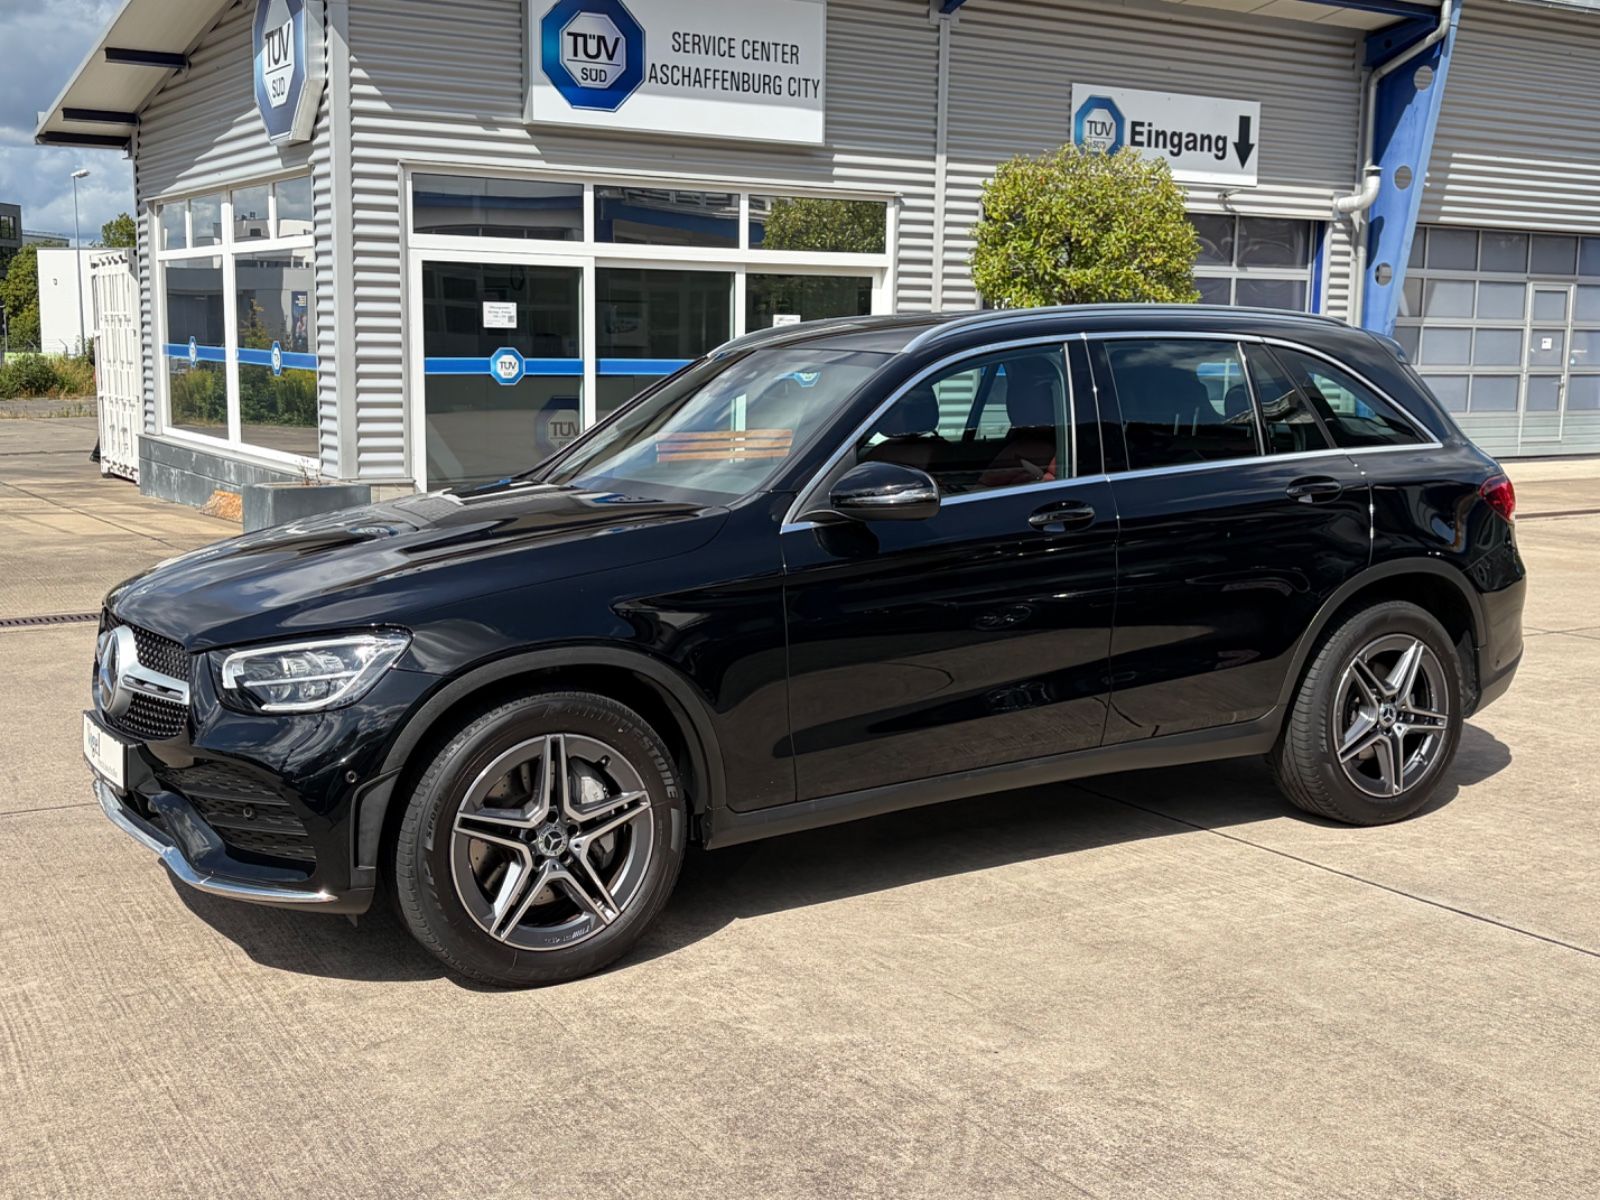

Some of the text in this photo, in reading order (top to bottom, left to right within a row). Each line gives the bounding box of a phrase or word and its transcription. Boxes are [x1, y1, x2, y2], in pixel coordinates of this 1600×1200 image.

[265, 23, 290, 67] TÜV
[567, 32, 621, 61] TÜV
[671, 31, 799, 64] SERVICE CENTER
[581, 68, 607, 83] SÜD
[648, 63, 820, 99] ASCHAFFENBURG CITY
[1087, 120, 1113, 136] TÜV
[1130, 120, 1228, 160] Eingang
